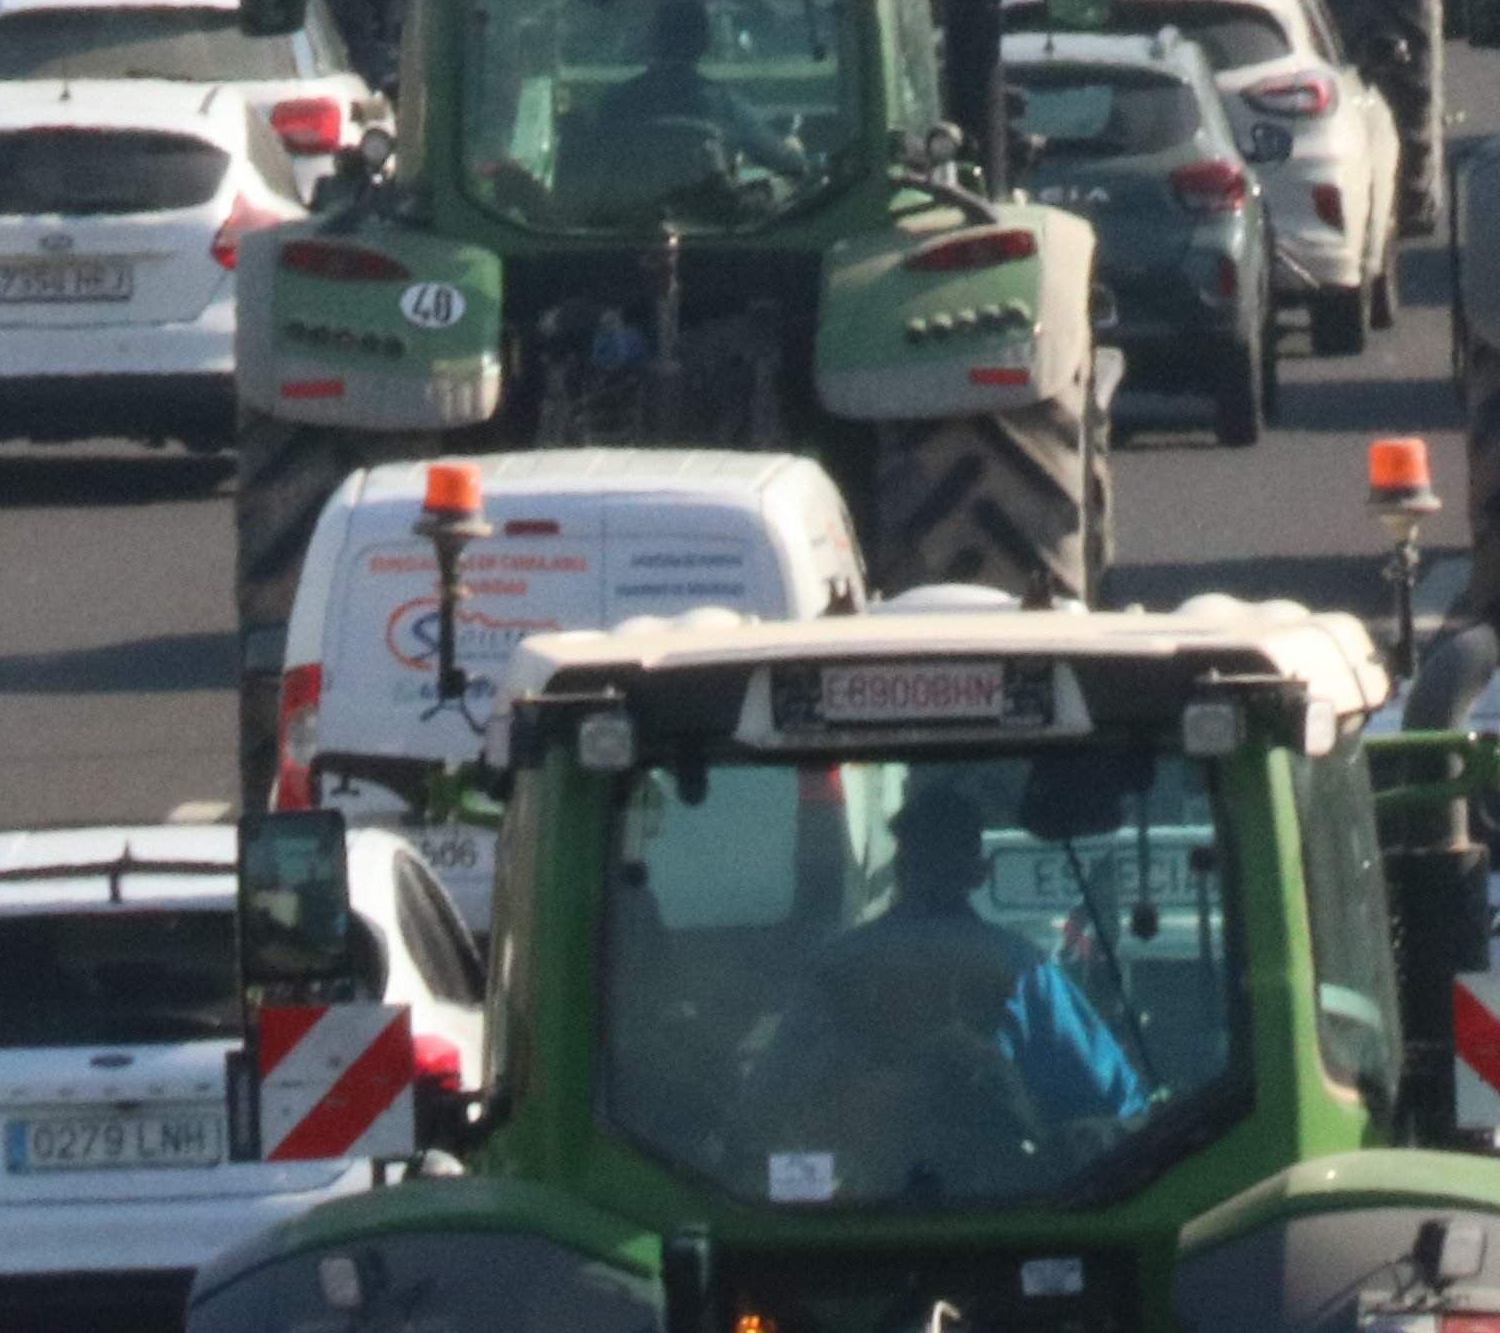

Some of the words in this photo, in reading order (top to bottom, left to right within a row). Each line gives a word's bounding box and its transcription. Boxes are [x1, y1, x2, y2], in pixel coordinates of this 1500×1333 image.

[409, 284, 455, 323] 40
[32, 1122, 124, 1161] 0279
[137, 1119, 208, 1159] LNH
